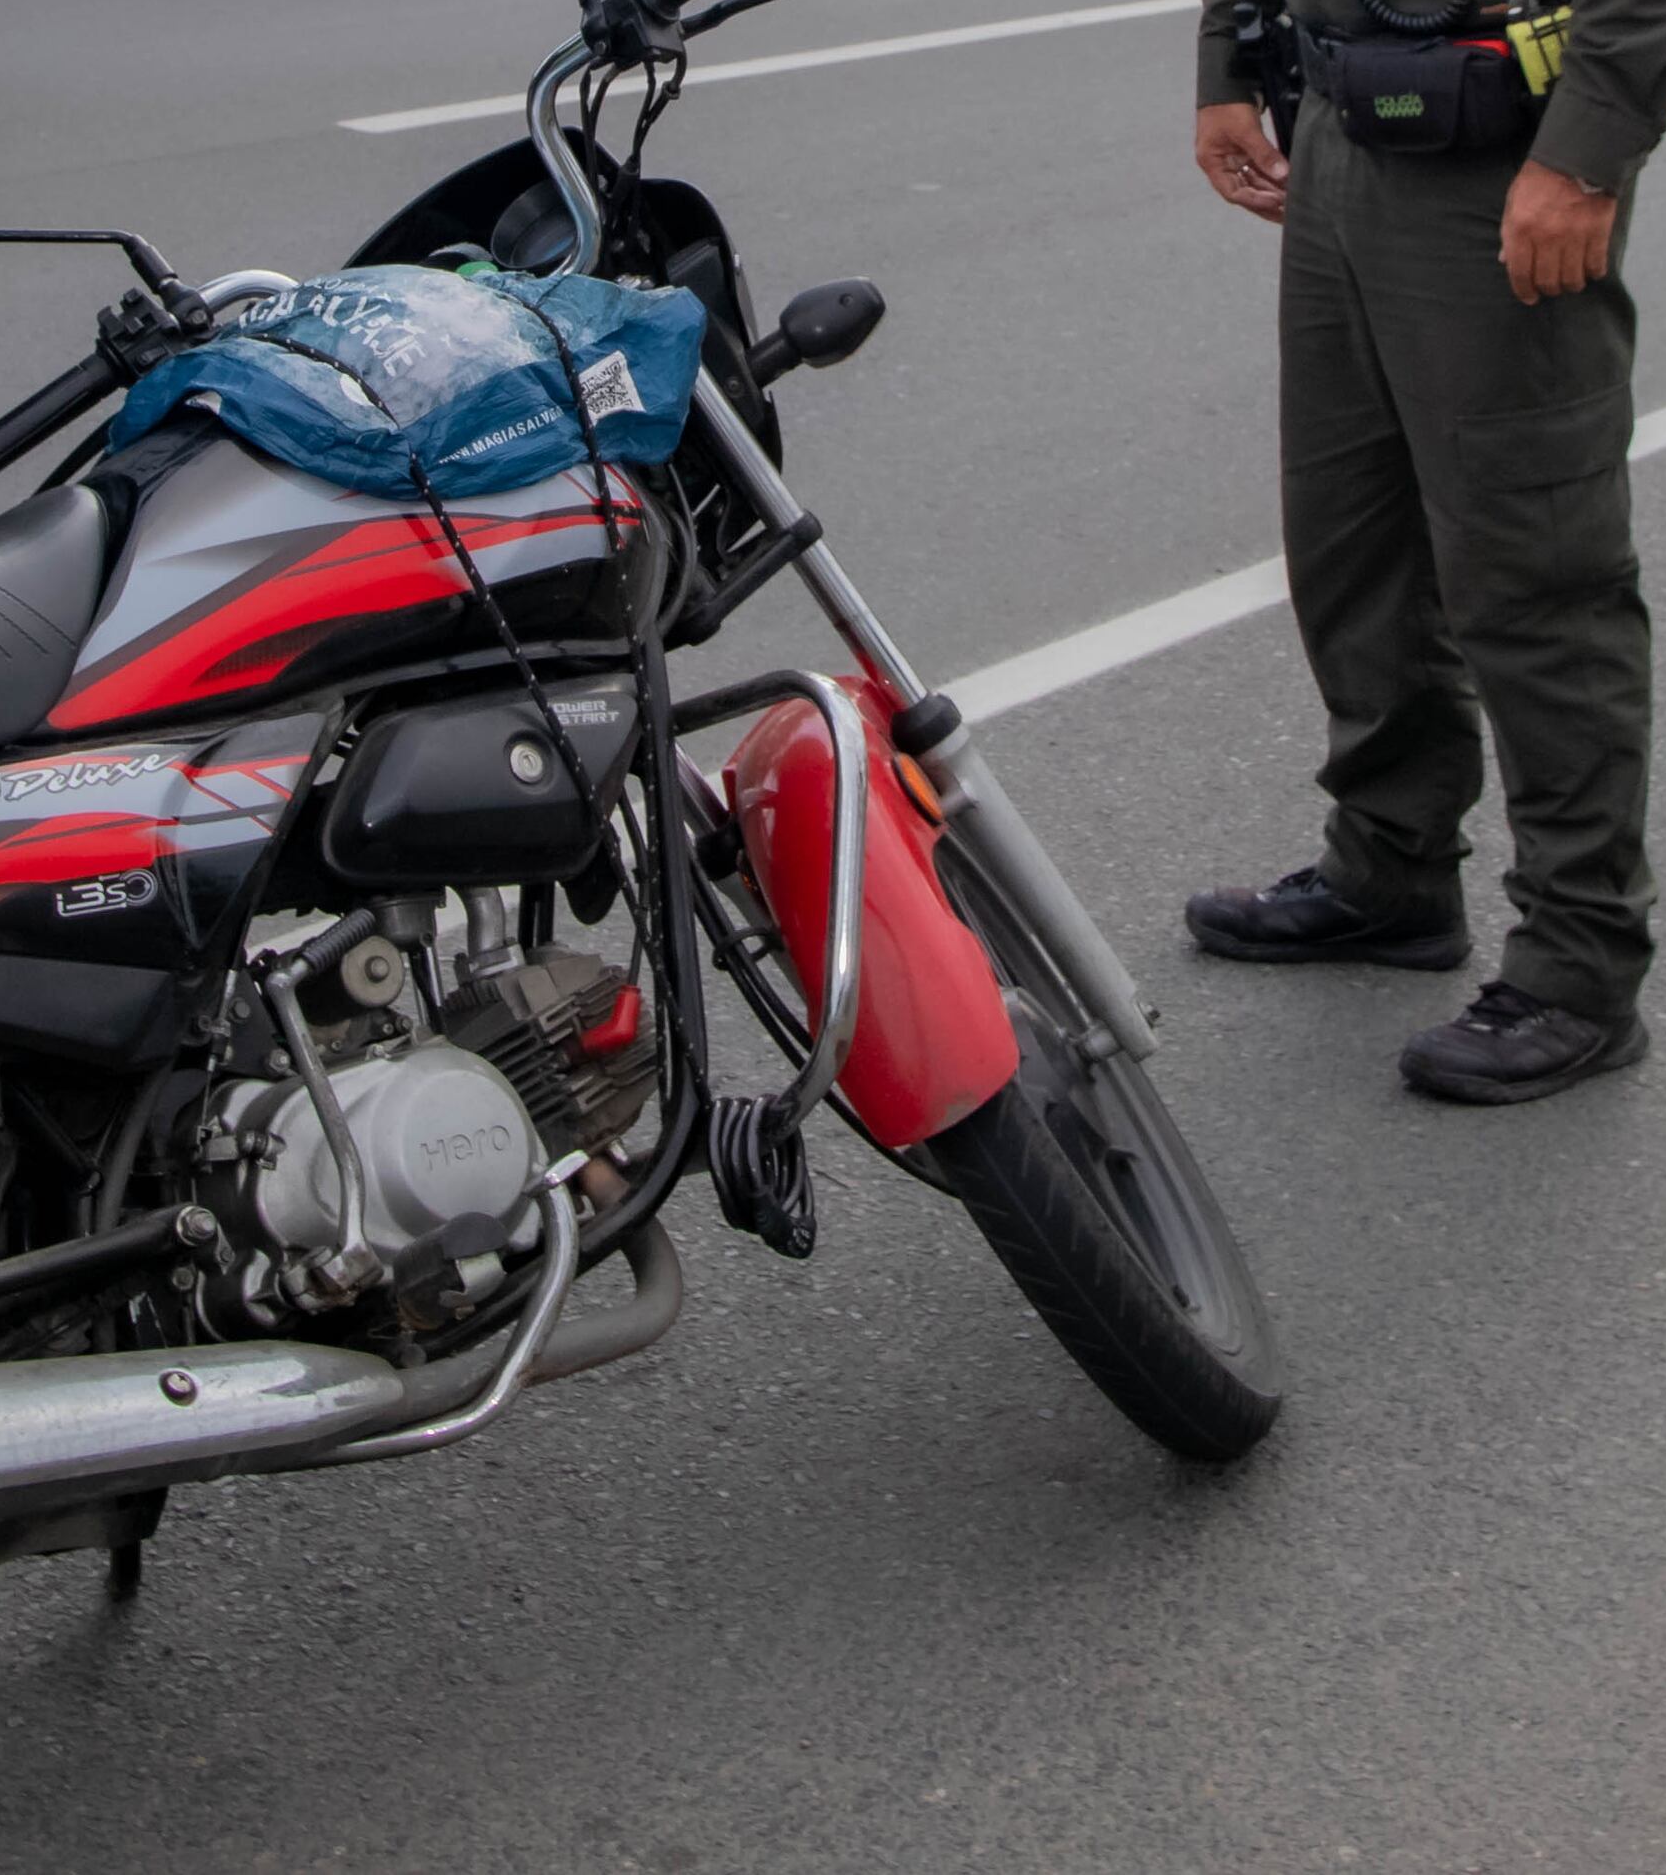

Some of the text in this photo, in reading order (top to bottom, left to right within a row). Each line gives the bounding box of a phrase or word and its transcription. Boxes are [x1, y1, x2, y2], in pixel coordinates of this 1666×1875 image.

[547, 700, 606, 714] OWER
[557, 711, 620, 725] START
[3, 753, 179, 802] Deluxe
[420, 1124, 512, 1172] Hero
